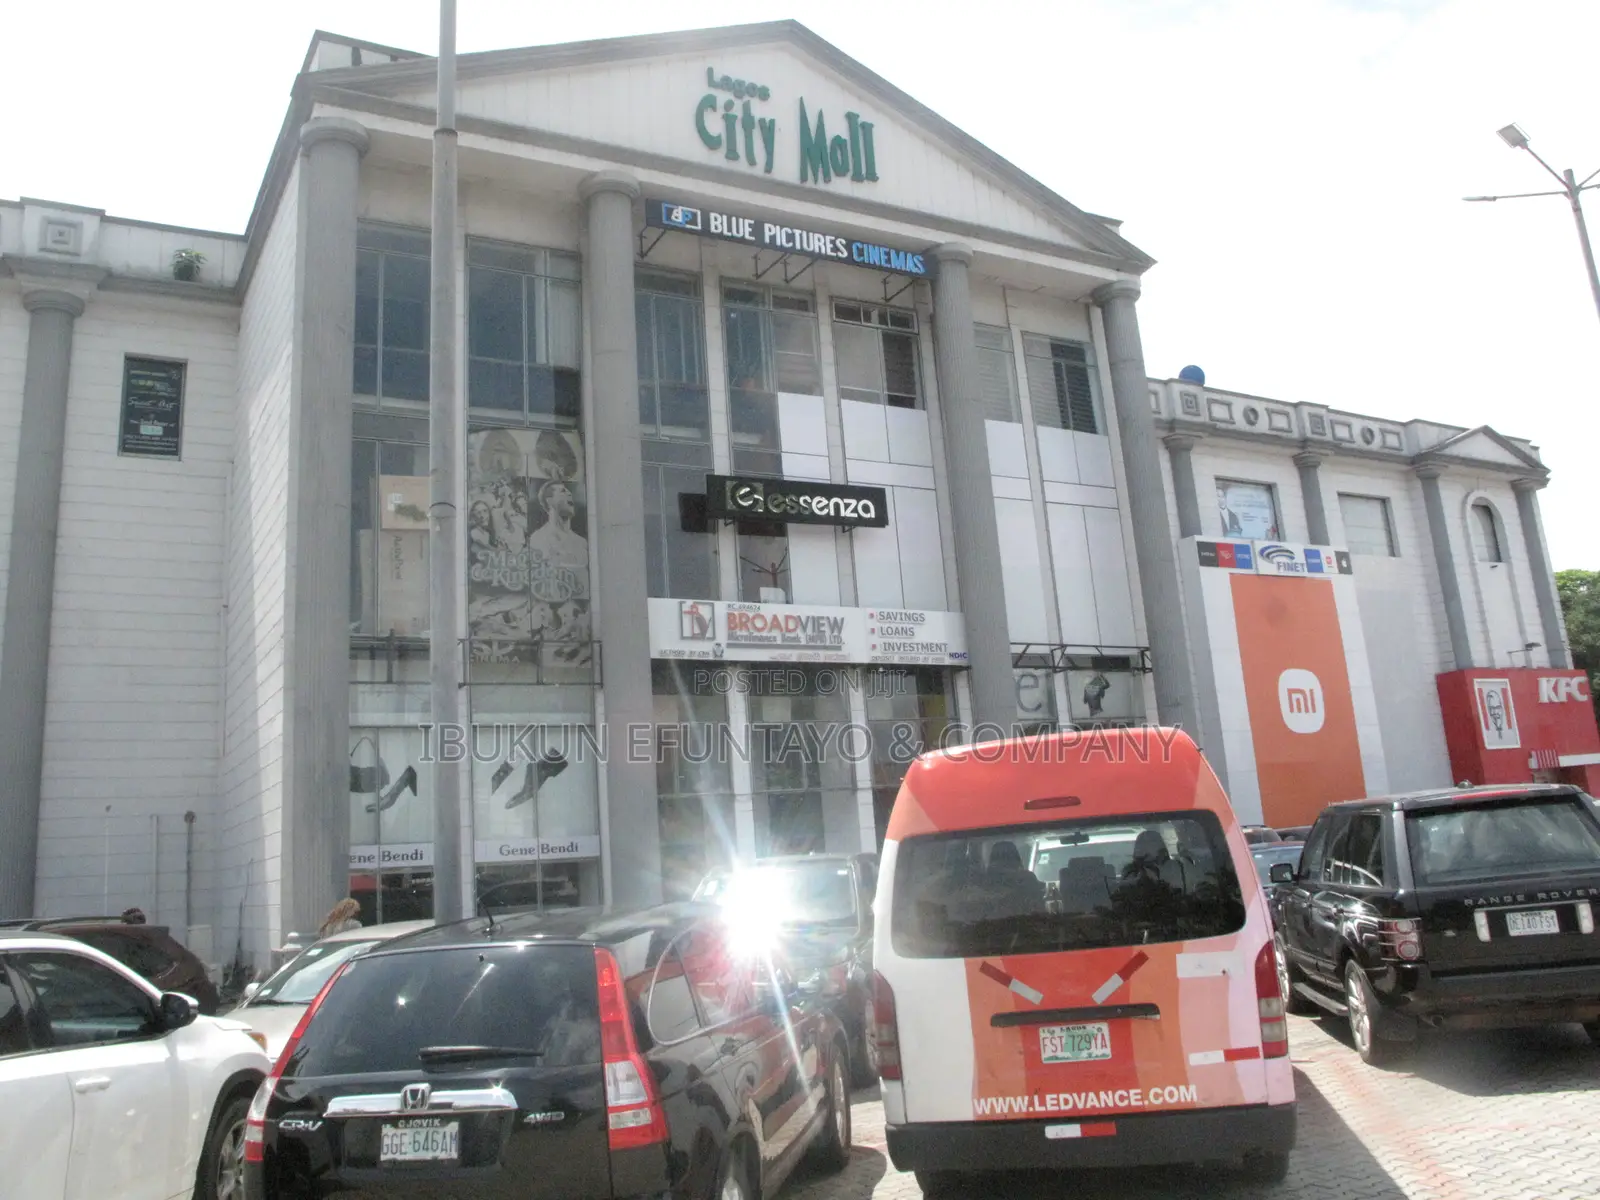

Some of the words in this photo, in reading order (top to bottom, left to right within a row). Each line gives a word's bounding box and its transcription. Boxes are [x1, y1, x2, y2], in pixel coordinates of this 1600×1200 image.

[706, 66, 771, 101] Lagos
[695, 93, 776, 174] City
[798, 95, 880, 184] Mall
[709, 212, 756, 241] BLUE
[763, 222, 848, 259] PICTURES
[852, 241, 925, 274] CINEMAS
[767, 492, 876, 519] essenza
[726, 611, 845, 635] BROADVIEW
[878, 611, 926, 623] SAVINGS
[879, 626, 916, 637] LOANS
[882, 642, 949, 653] INVESTMENT
[1537, 676, 1588, 704] KFC
[350, 853, 375, 864] ene
[381, 850, 425, 863] Bendi
[499, 843, 537, 857] Gene
[540, 841, 580, 855] Bendi
[1464, 894, 1526, 906] RANGE
[1537, 887, 1598, 900] ROVER
[972, 1084, 1199, 1114] WWW.LEDVANCE.COM
